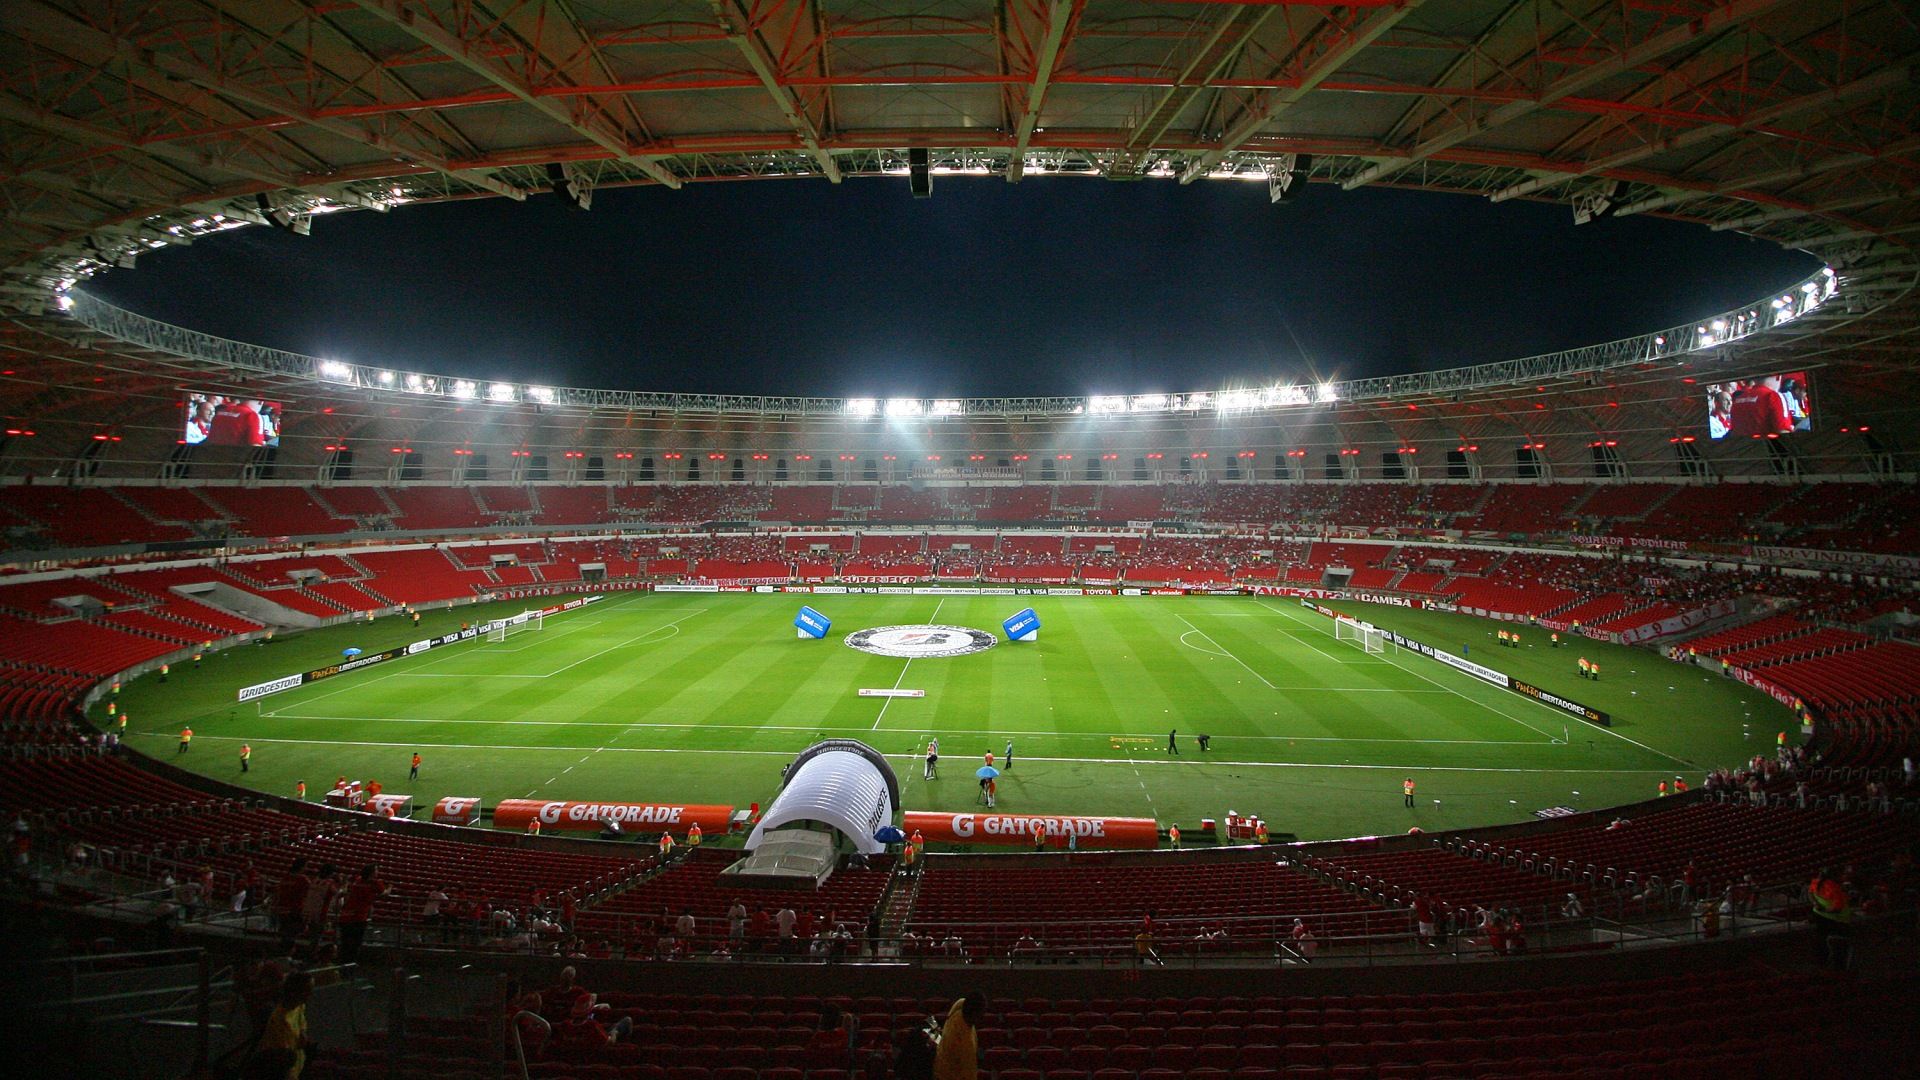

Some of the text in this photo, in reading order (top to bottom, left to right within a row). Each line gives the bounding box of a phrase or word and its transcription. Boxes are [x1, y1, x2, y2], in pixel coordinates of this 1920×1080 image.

[1361, 593, 1412, 608] CAMISA
[801, 613, 815, 626] VISA
[1009, 621, 1025, 633] VISA
[443, 632, 459, 644] VISA
[461, 628, 477, 639] VISA
[479, 623, 491, 634] VISA
[1406, 638, 1419, 652] VISA
[1420, 643, 1434, 657] VISA
[241, 675, 302, 699] BRIDGESTONE
[568, 804, 684, 824] GATORADE
[983, 816, 1105, 838] GATORADE
